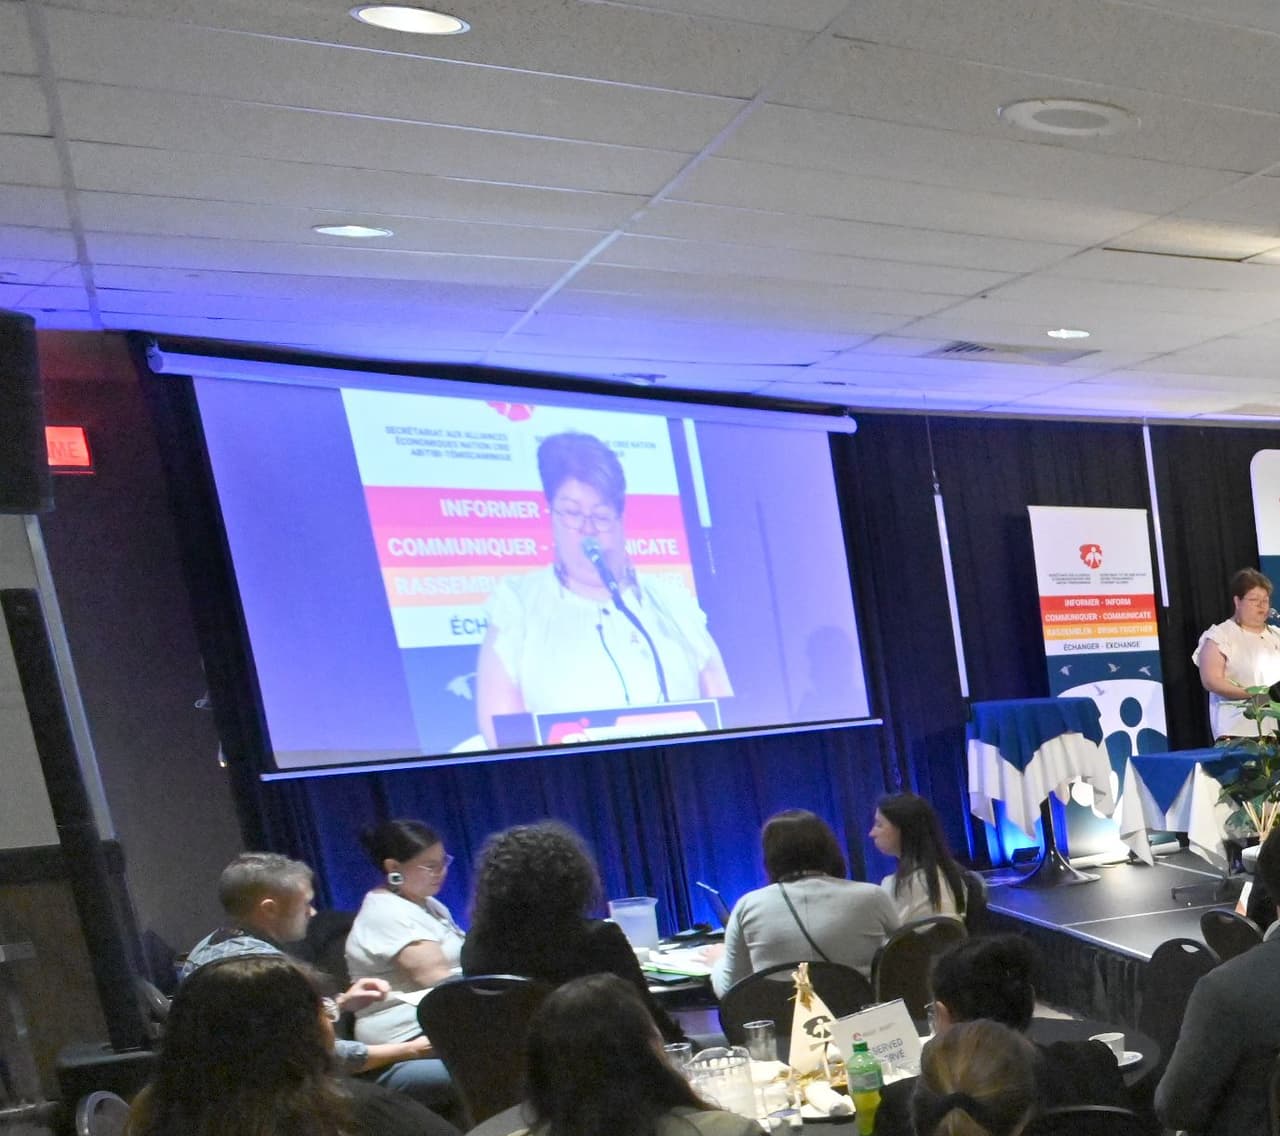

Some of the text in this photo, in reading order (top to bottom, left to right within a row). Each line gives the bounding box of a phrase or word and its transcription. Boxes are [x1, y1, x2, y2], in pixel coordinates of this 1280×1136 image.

[440, 498, 540, 518] INFORMER
[387, 537, 537, 557] COMMUNIQUER
[625, 538, 679, 556] NICATE
[394, 575, 496, 596] RASSEMB
[1064, 598, 1100, 607] INFORMER
[1105, 598, 1132, 606] INFORM
[1045, 613, 1098, 622] COMMUNIQUER
[1103, 611, 1152, 619] COMMUNICATE
[1064, 642, 1100, 651] ÉCHANGER
[1106, 641, 1140, 649] EXCHANGE
[872, 1038, 903, 1056] SERVED
